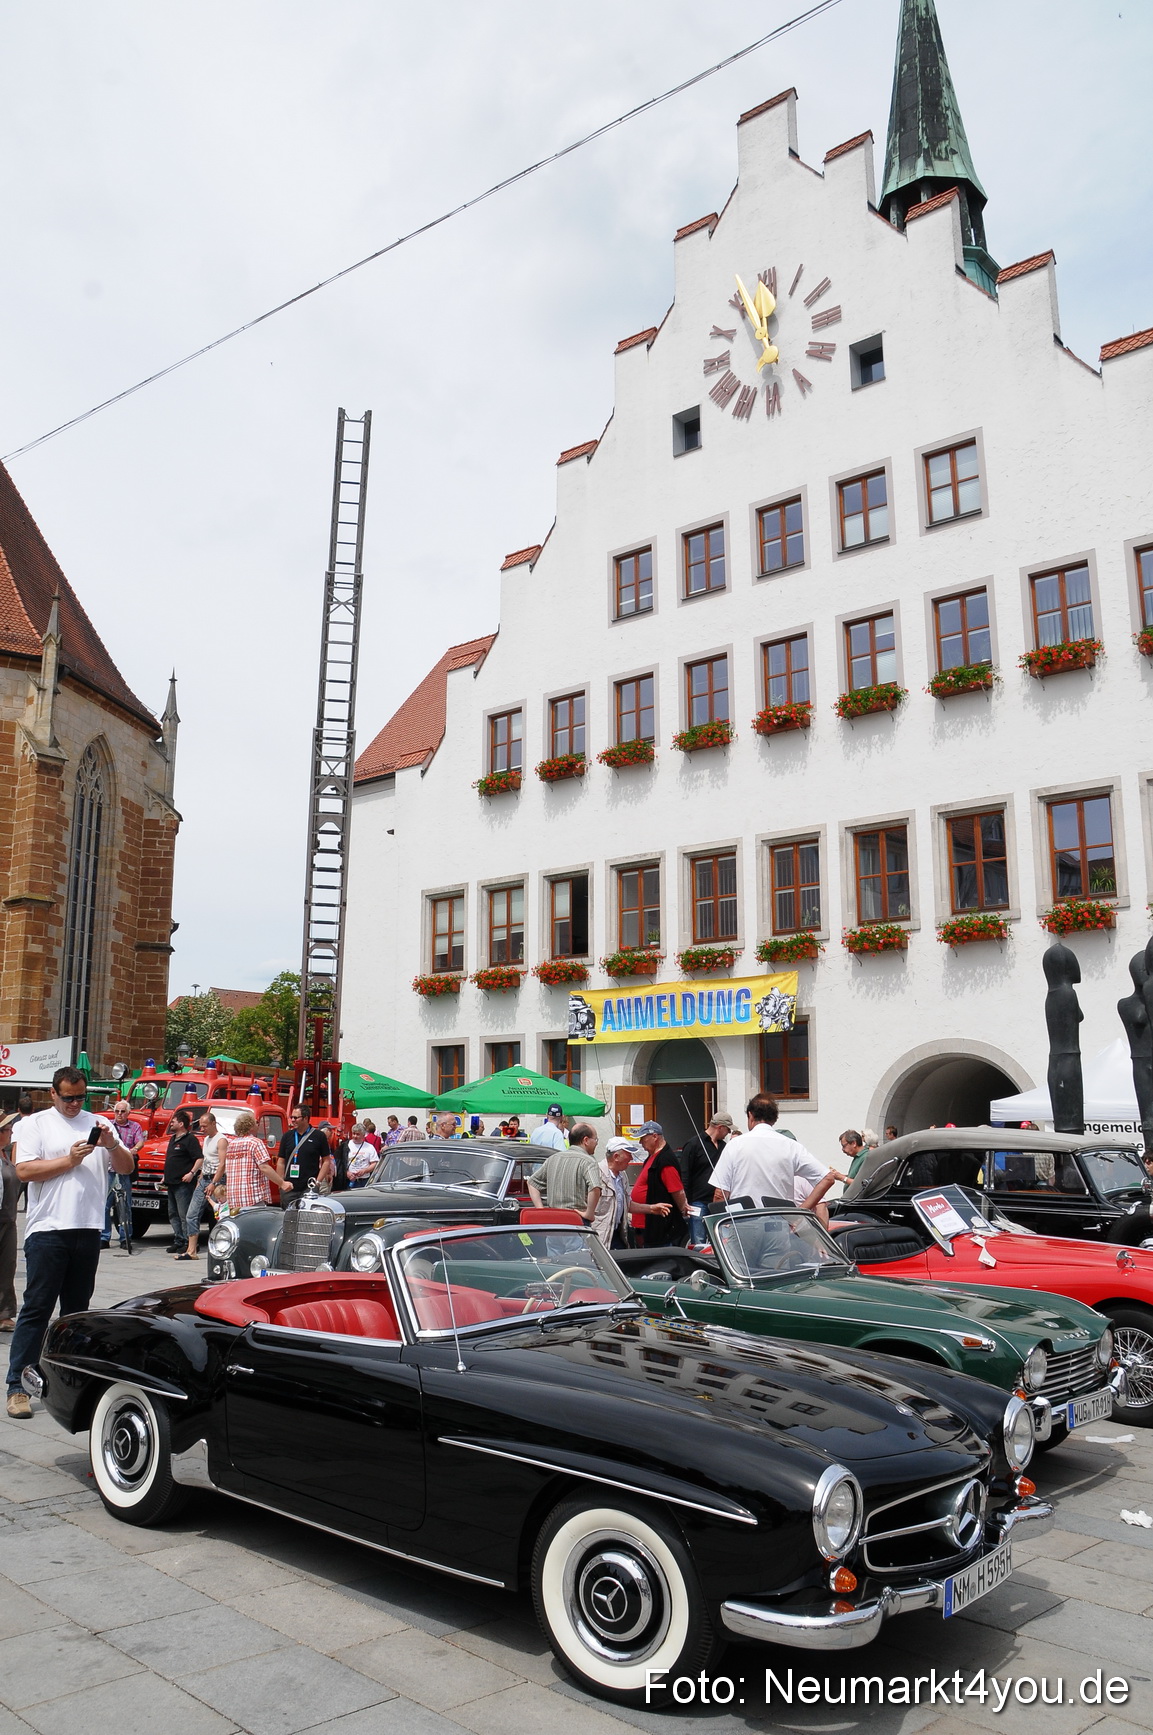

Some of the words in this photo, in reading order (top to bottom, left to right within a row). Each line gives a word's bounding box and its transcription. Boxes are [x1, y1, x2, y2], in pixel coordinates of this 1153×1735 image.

[600, 988, 752, 1033] ANMELDUNG
[1074, 1402, 1088, 1424] WUG
[953, 1573, 970, 1609] NM
